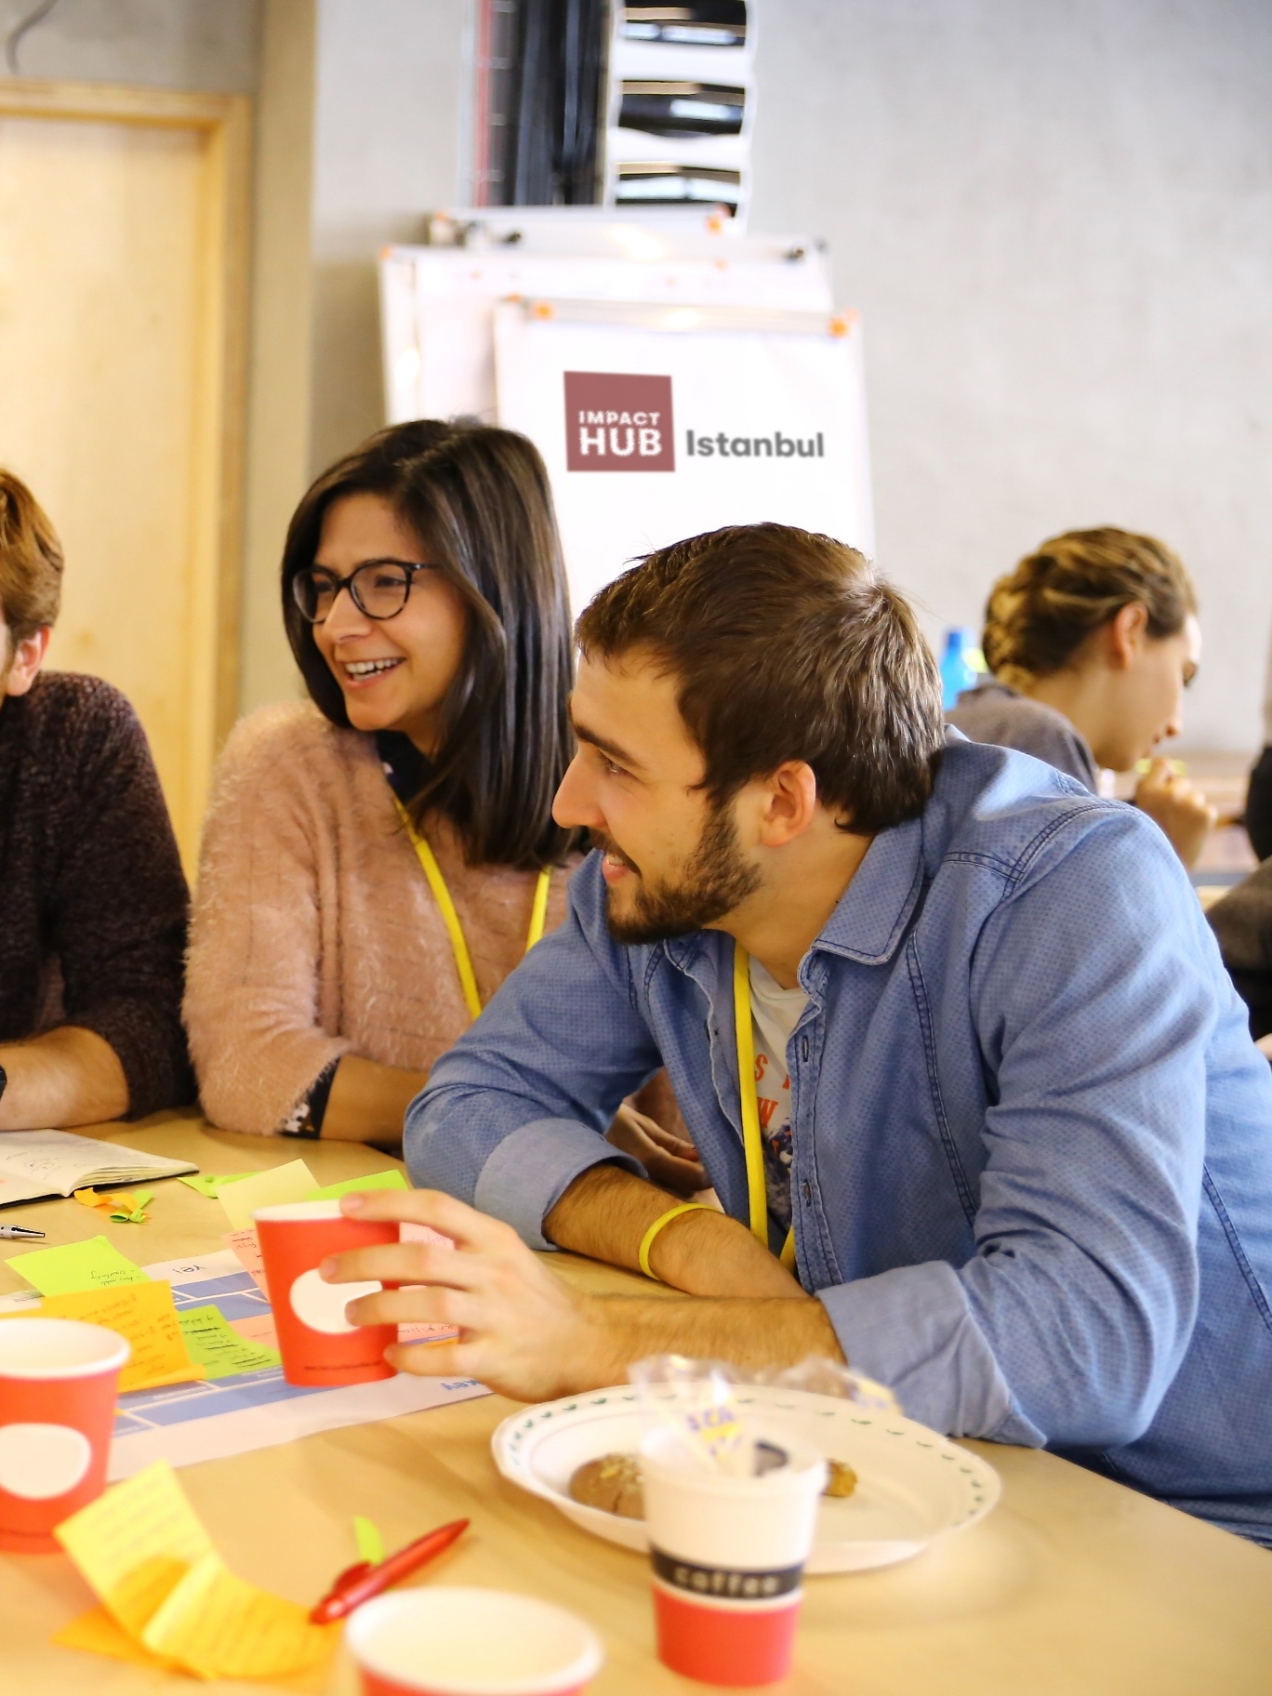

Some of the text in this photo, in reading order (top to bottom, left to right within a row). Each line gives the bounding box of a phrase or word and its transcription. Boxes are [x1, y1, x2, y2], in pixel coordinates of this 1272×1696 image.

[578, 410, 661, 426] IMPACT
[579, 426, 663, 457] HUB
[686, 429, 825, 458] Istanbul
[674, 1566, 778, 1594] coffee
